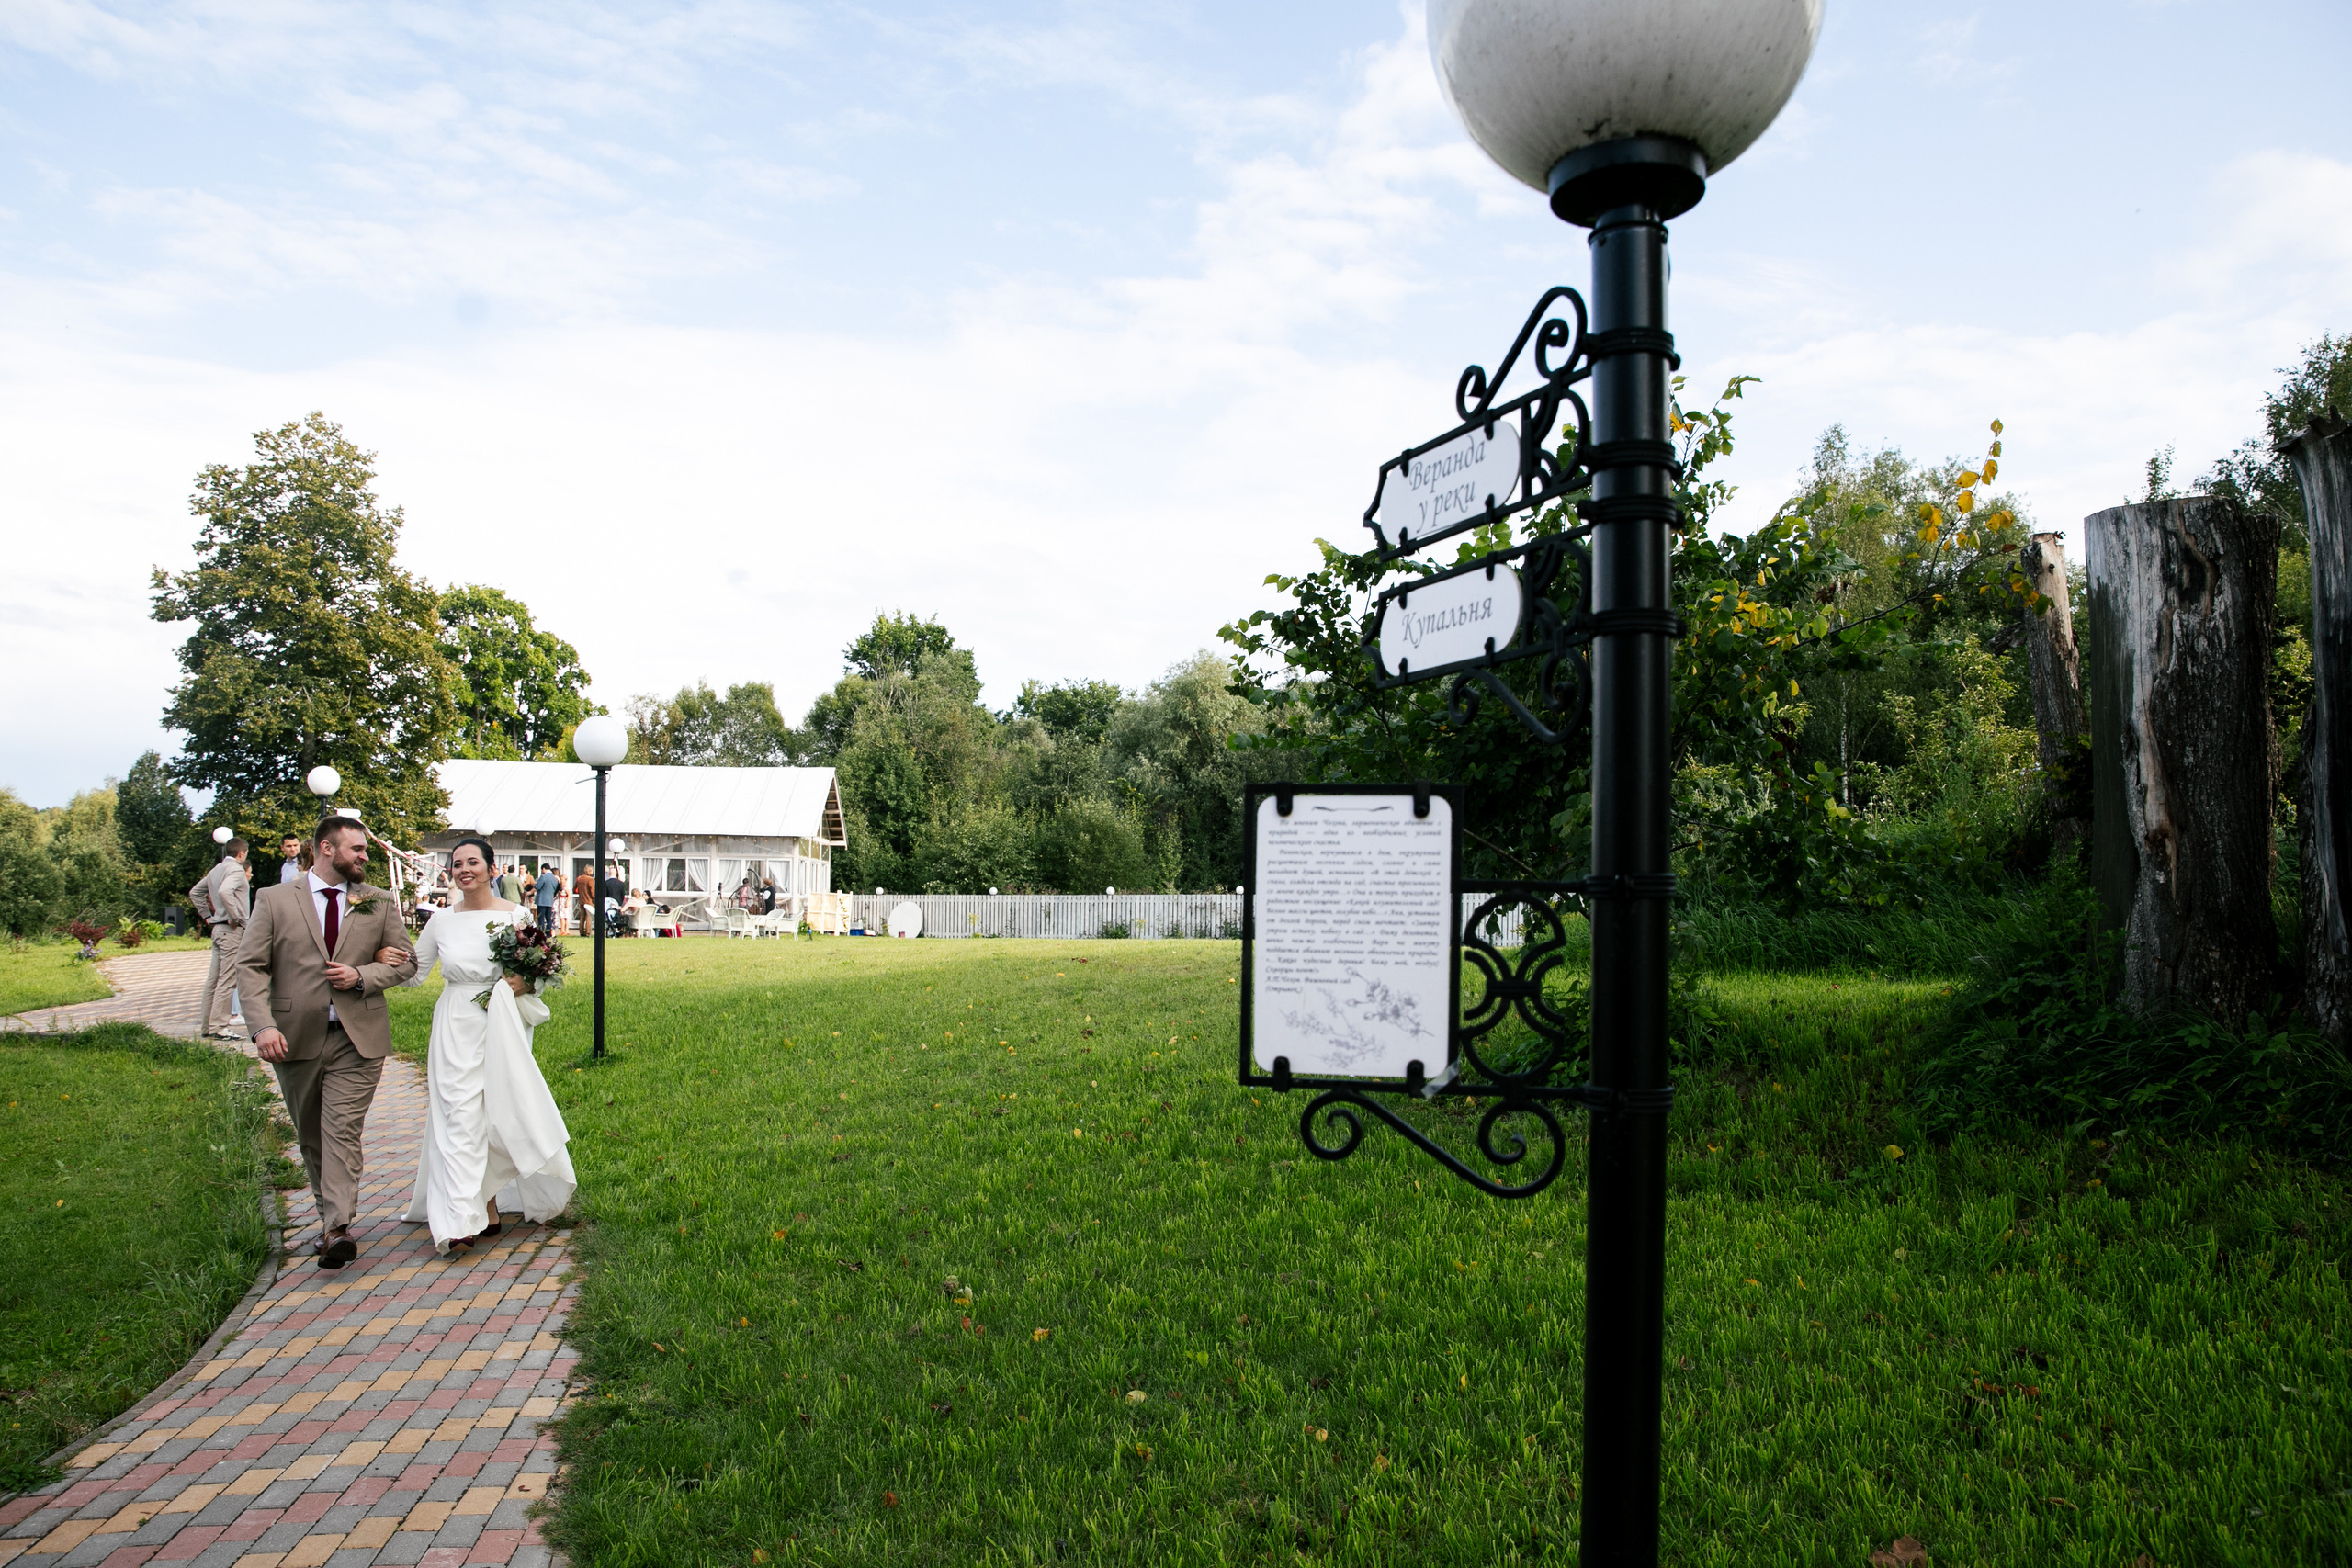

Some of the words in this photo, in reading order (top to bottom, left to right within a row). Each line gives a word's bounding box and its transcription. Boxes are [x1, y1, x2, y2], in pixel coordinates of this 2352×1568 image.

[1409, 434, 1486, 493] Веранда
[1416, 499, 1430, 534] у
[1431, 480, 1476, 527] реки
[1402, 596, 1493, 649] Купальня
